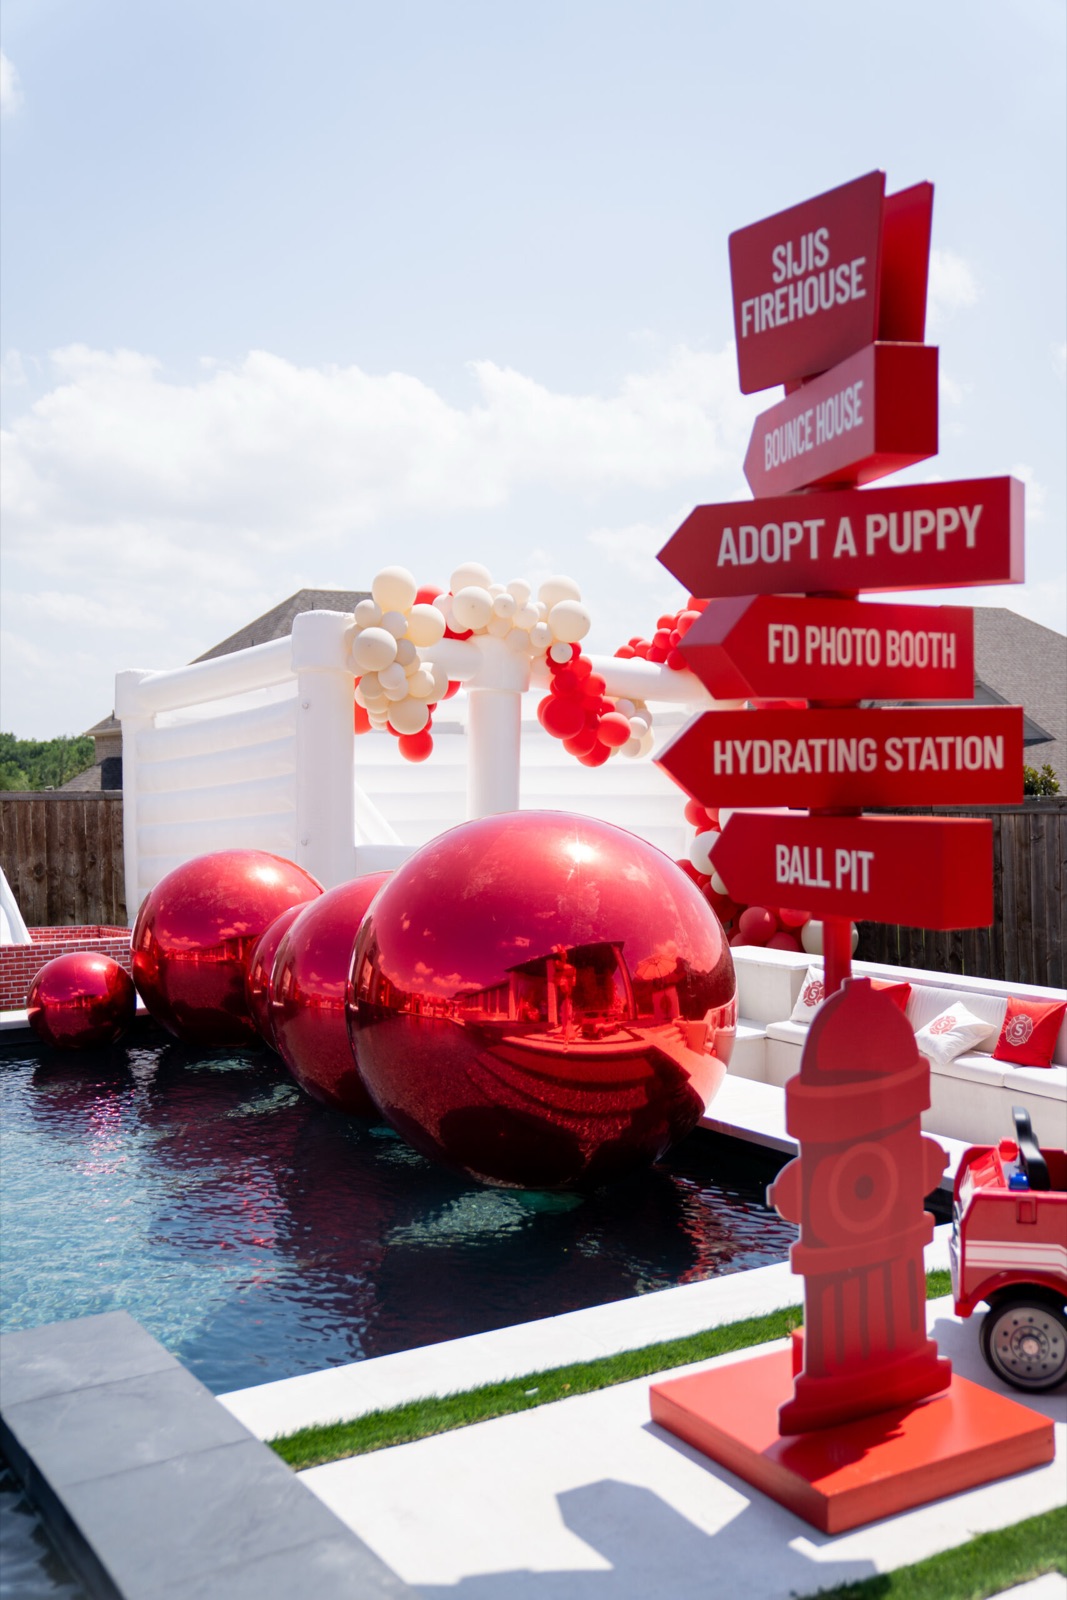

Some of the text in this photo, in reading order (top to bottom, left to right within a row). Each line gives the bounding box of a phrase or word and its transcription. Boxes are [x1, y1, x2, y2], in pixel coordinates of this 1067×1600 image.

[772, 227, 829, 283] SIJIS
[741, 257, 866, 337] FIREHOUSE
[764, 381, 863, 471] BOUNCE HOUSE
[717, 505, 983, 566] ADOPT A PUPPY
[768, 624, 956, 669] FD PHOTO BOOTH
[713, 736, 1004, 775] HYDRATING STATION
[775, 844, 874, 893] BALL PIT
[809, 988, 818, 999] S
[936, 1020, 949, 1029] S
[1014, 1023, 1024, 1036] S
